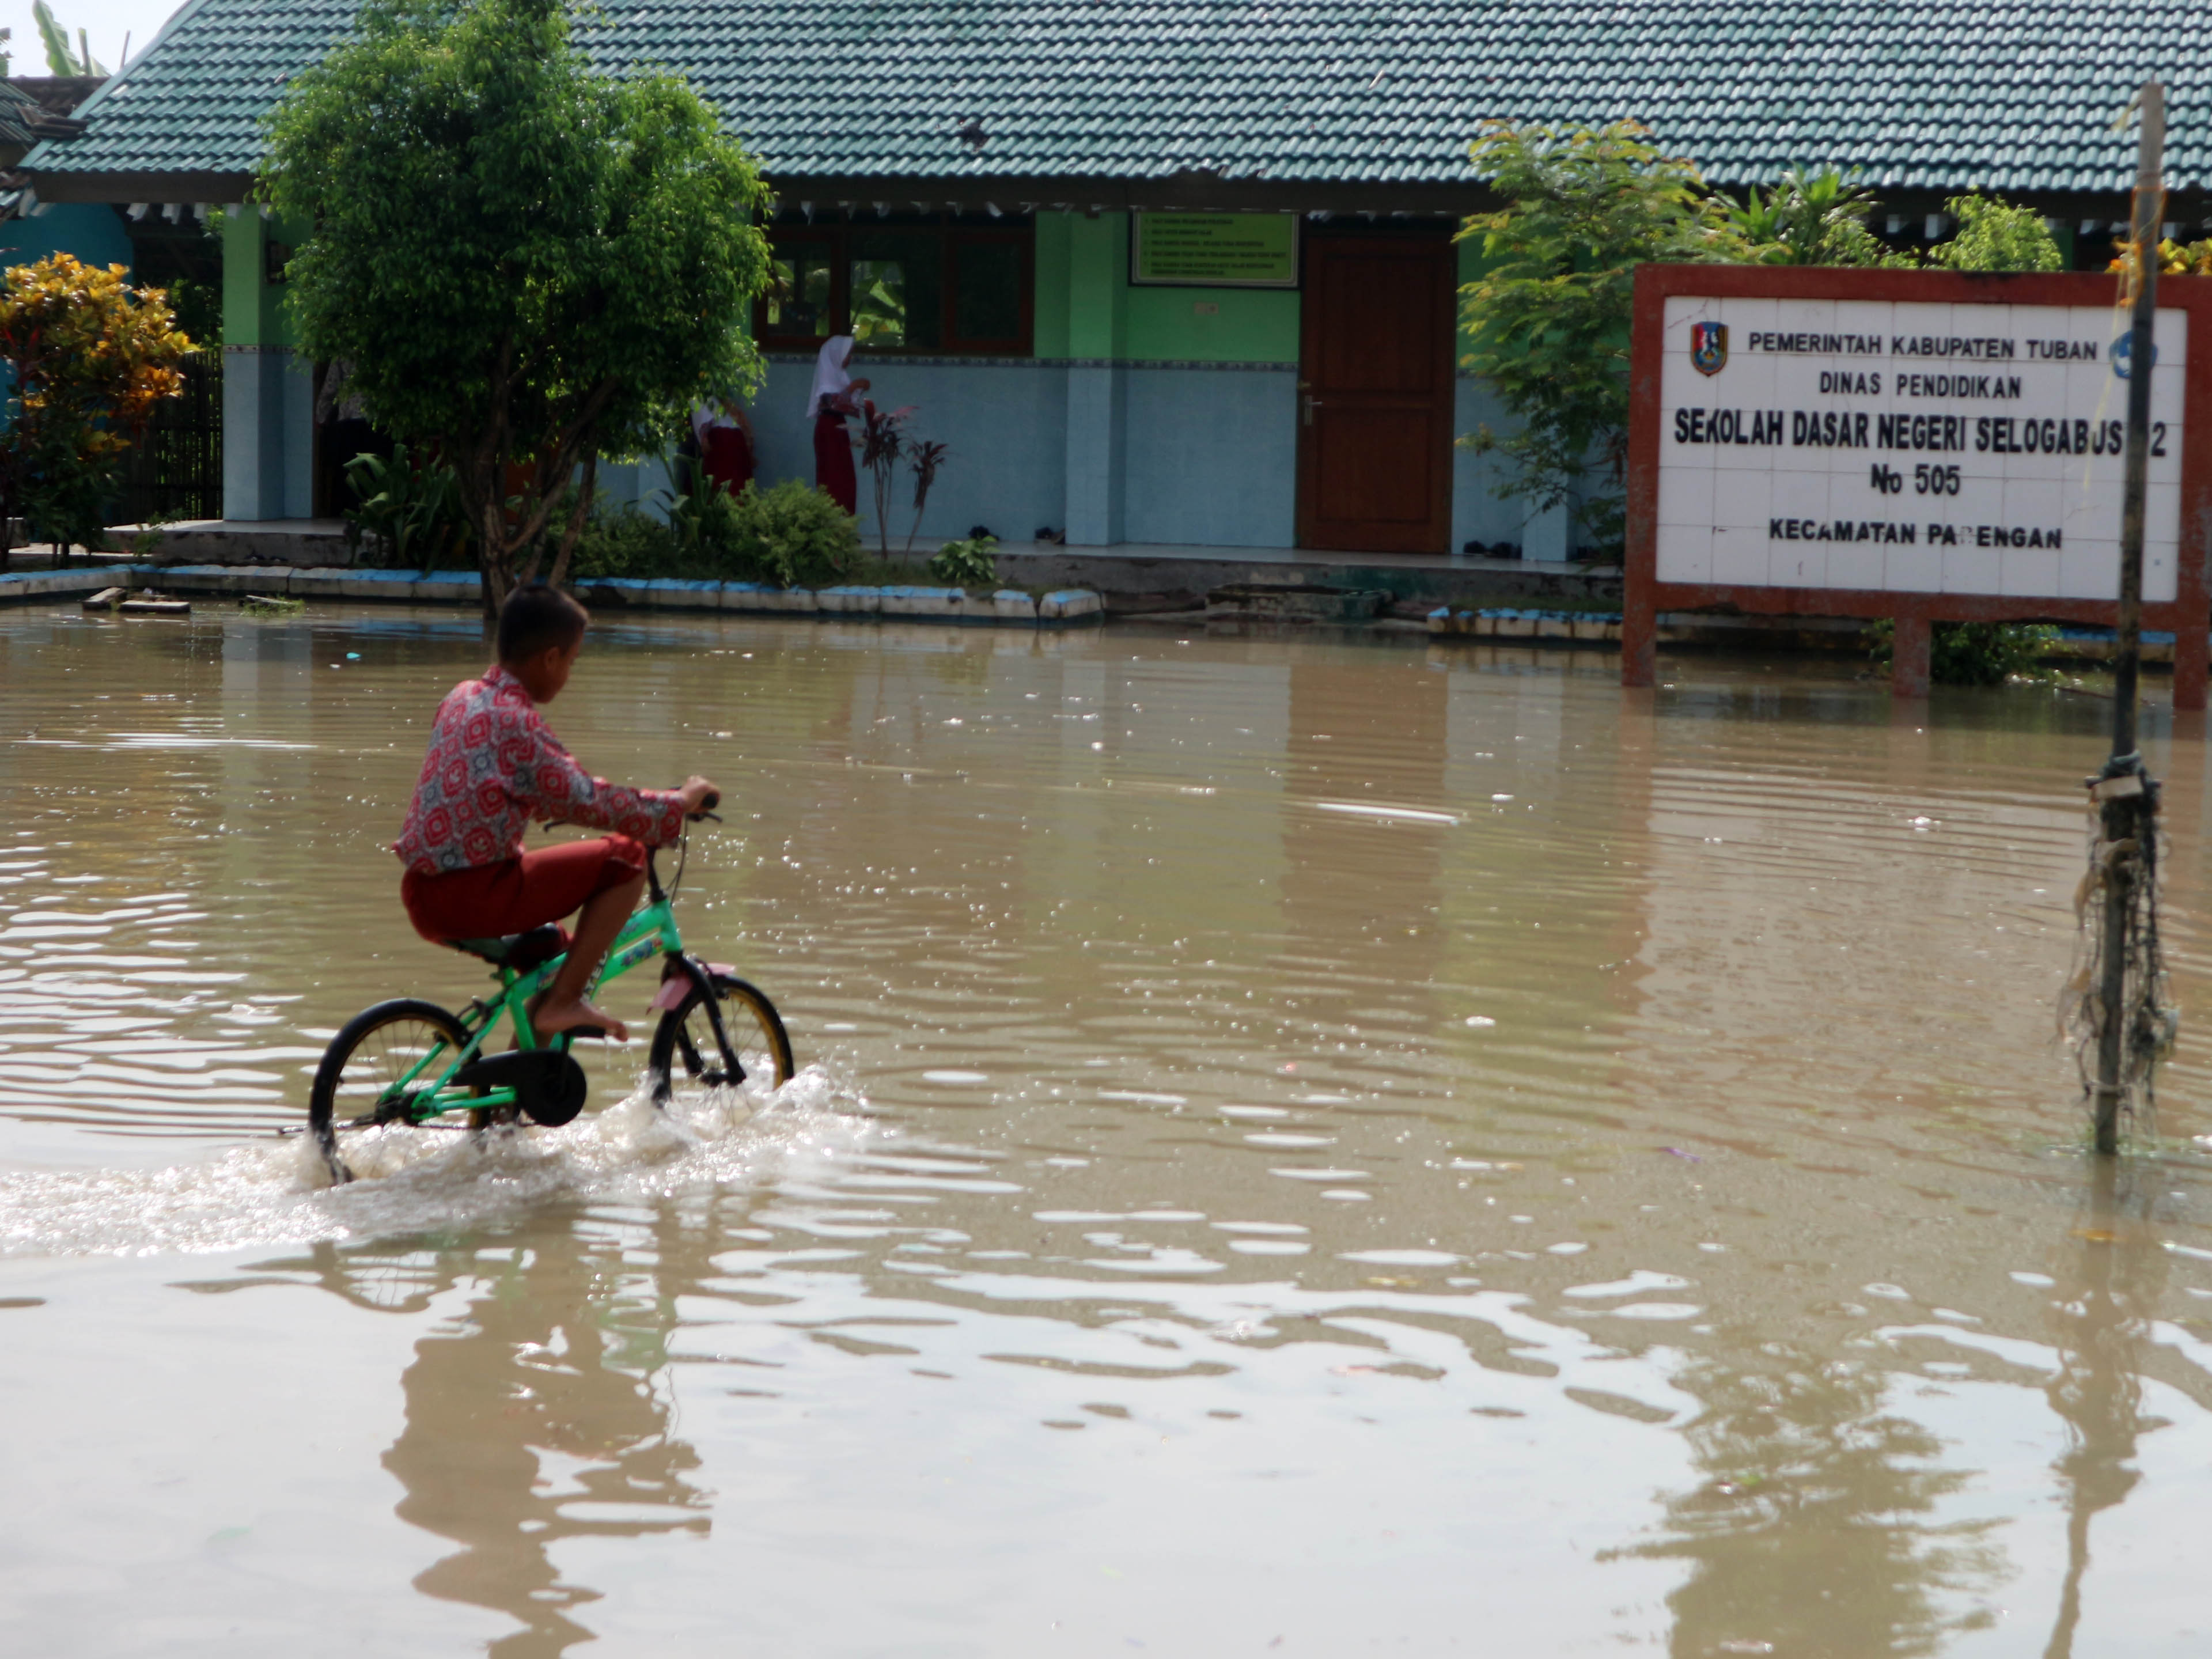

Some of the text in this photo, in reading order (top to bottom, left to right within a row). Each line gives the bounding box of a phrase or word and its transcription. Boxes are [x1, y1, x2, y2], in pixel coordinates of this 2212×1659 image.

[1749, 332, 2097, 361] PEMERINTAH KABUPATEN TUBAN
[1820, 371, 2021, 399] DINAS PENDIDIKAN
[1674, 407, 2166, 457] SEKOLAH DASAR NEGERI SELOGABUS 2
[1870, 463, 1961, 497] No 505
[1769, 518, 1916, 544] KECAMATAN
